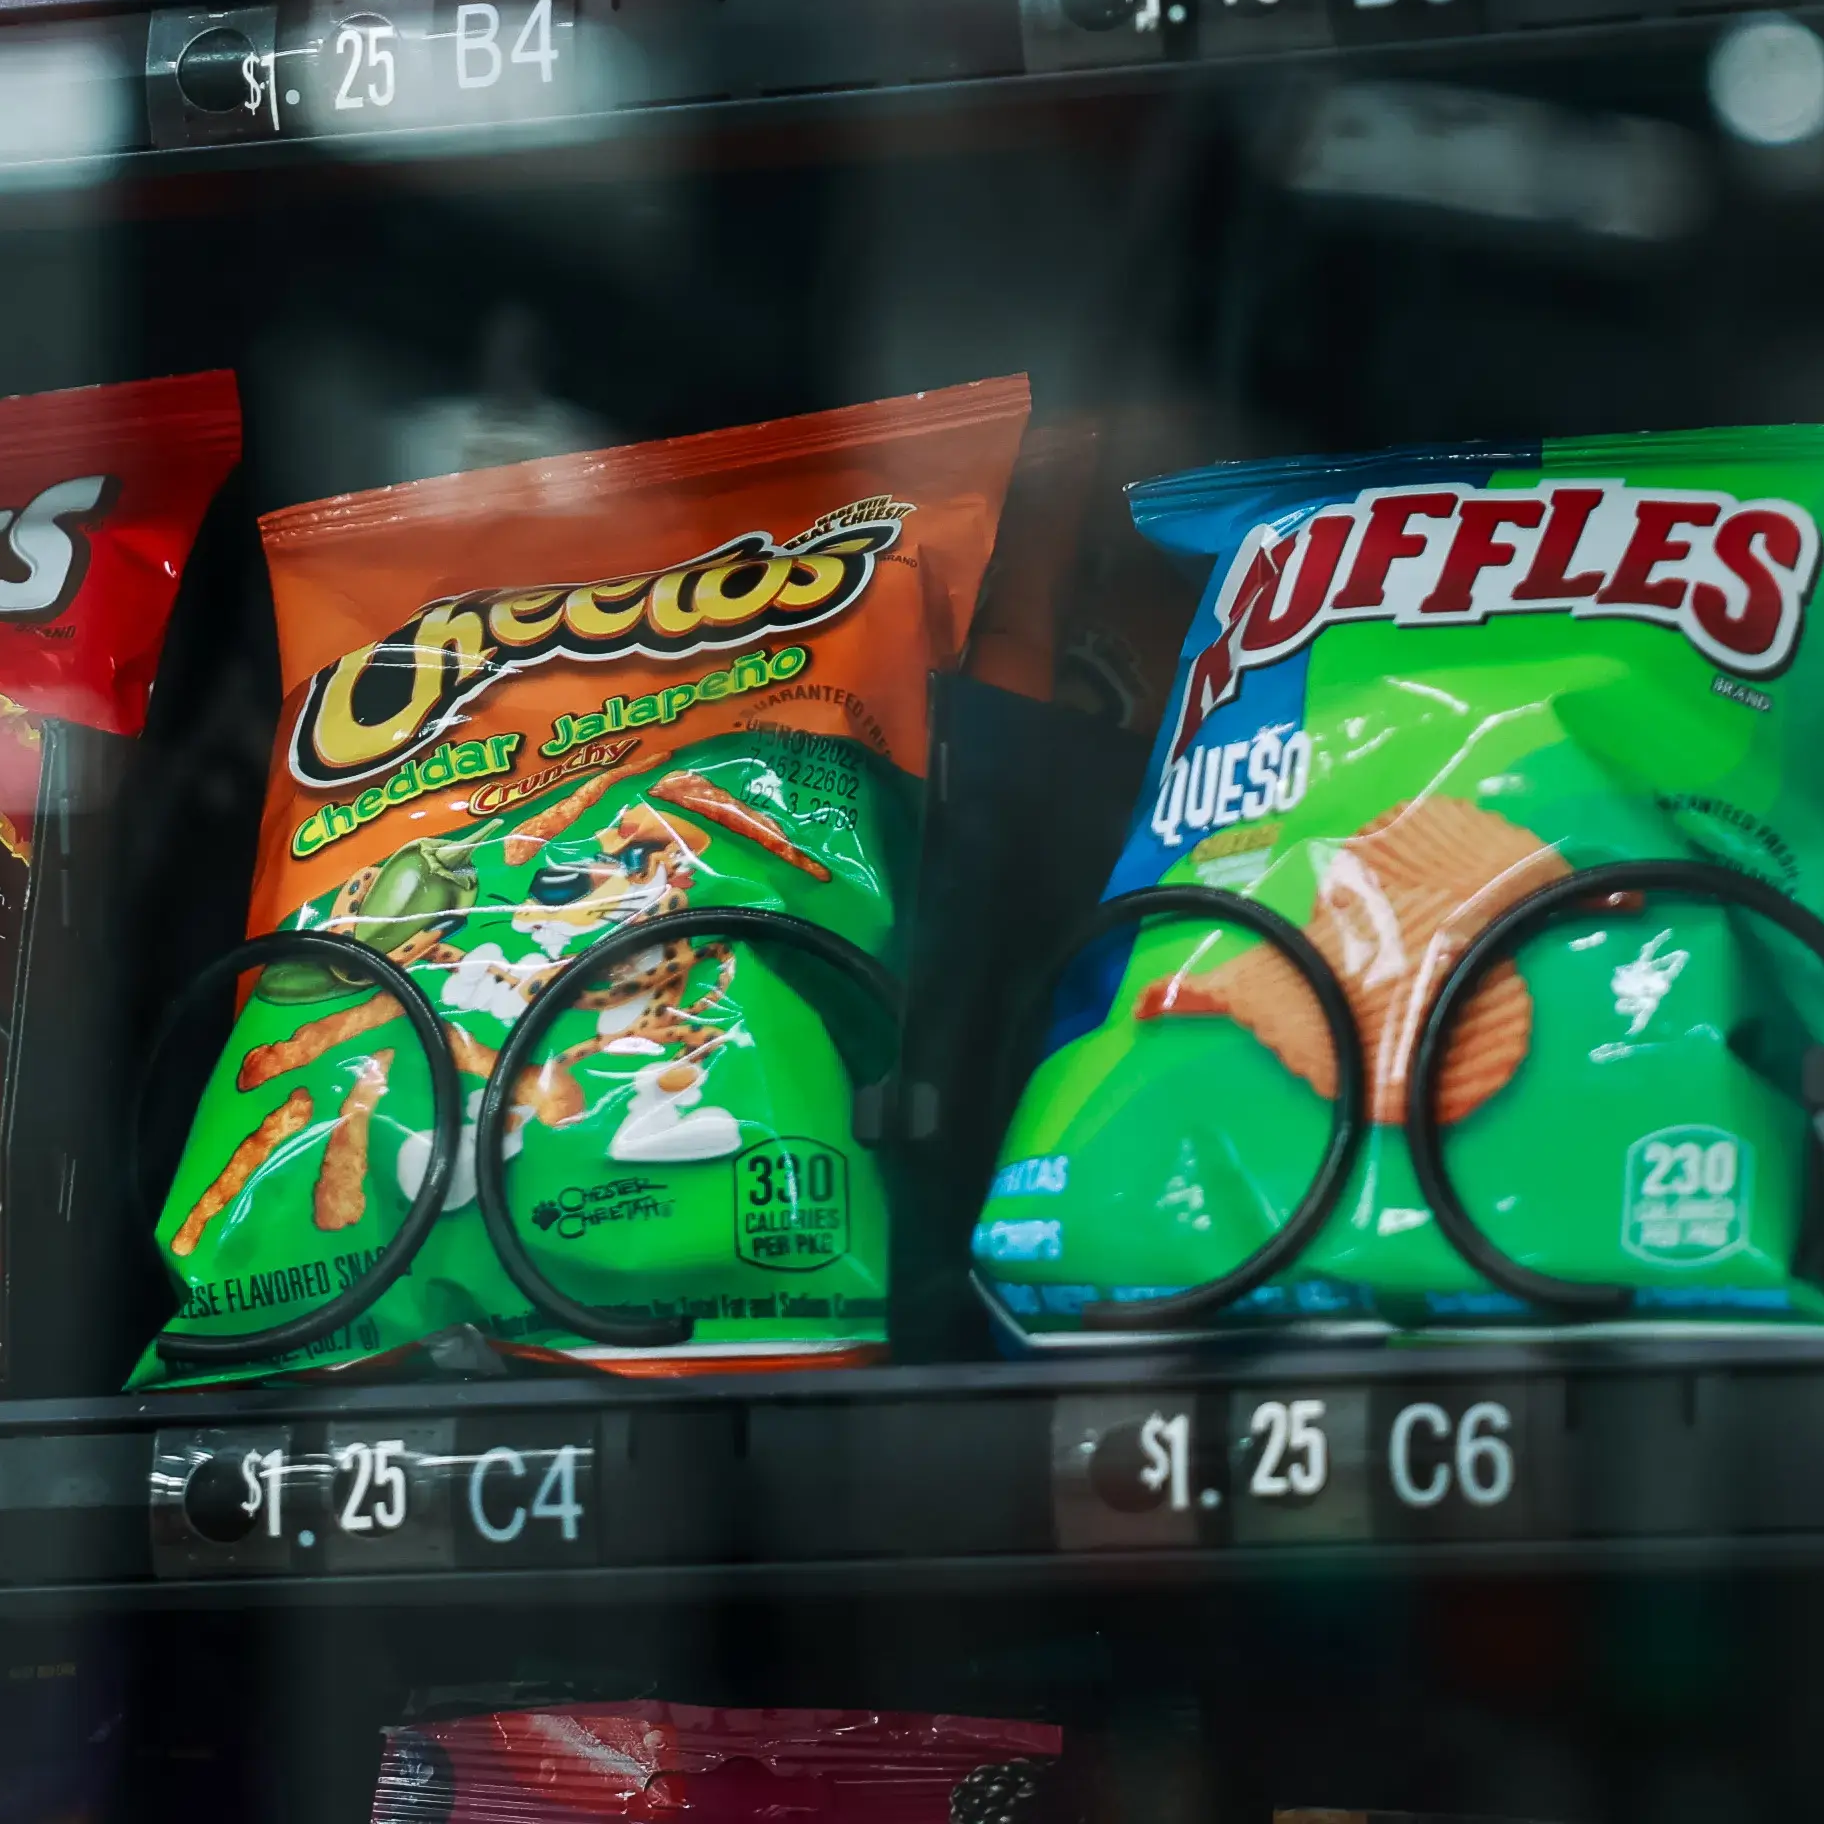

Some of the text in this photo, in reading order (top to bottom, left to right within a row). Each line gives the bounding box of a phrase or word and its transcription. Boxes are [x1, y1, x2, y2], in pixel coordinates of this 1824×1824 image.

[784, 523, 835, 551] REAL
[315, 538, 874, 764] Cheetos
[288, 643, 809, 859] Cheddar Jalapeño
[467, 736, 641, 816] Crunchy
[1150, 725, 1312, 846] QUESO
[557, 1177, 668, 1213] CHESTER
[748, 1152, 835, 1206] 330
[1640, 1140, 1736, 1197] 230
[744, 1207, 841, 1234] CALORIES
[752, 1236, 792, 1257] PER
[224, 1260, 331, 1313] FLAVORED
[1387, 1399, 1515, 1507] C6
[467, 1444, 585, 1542] C4
